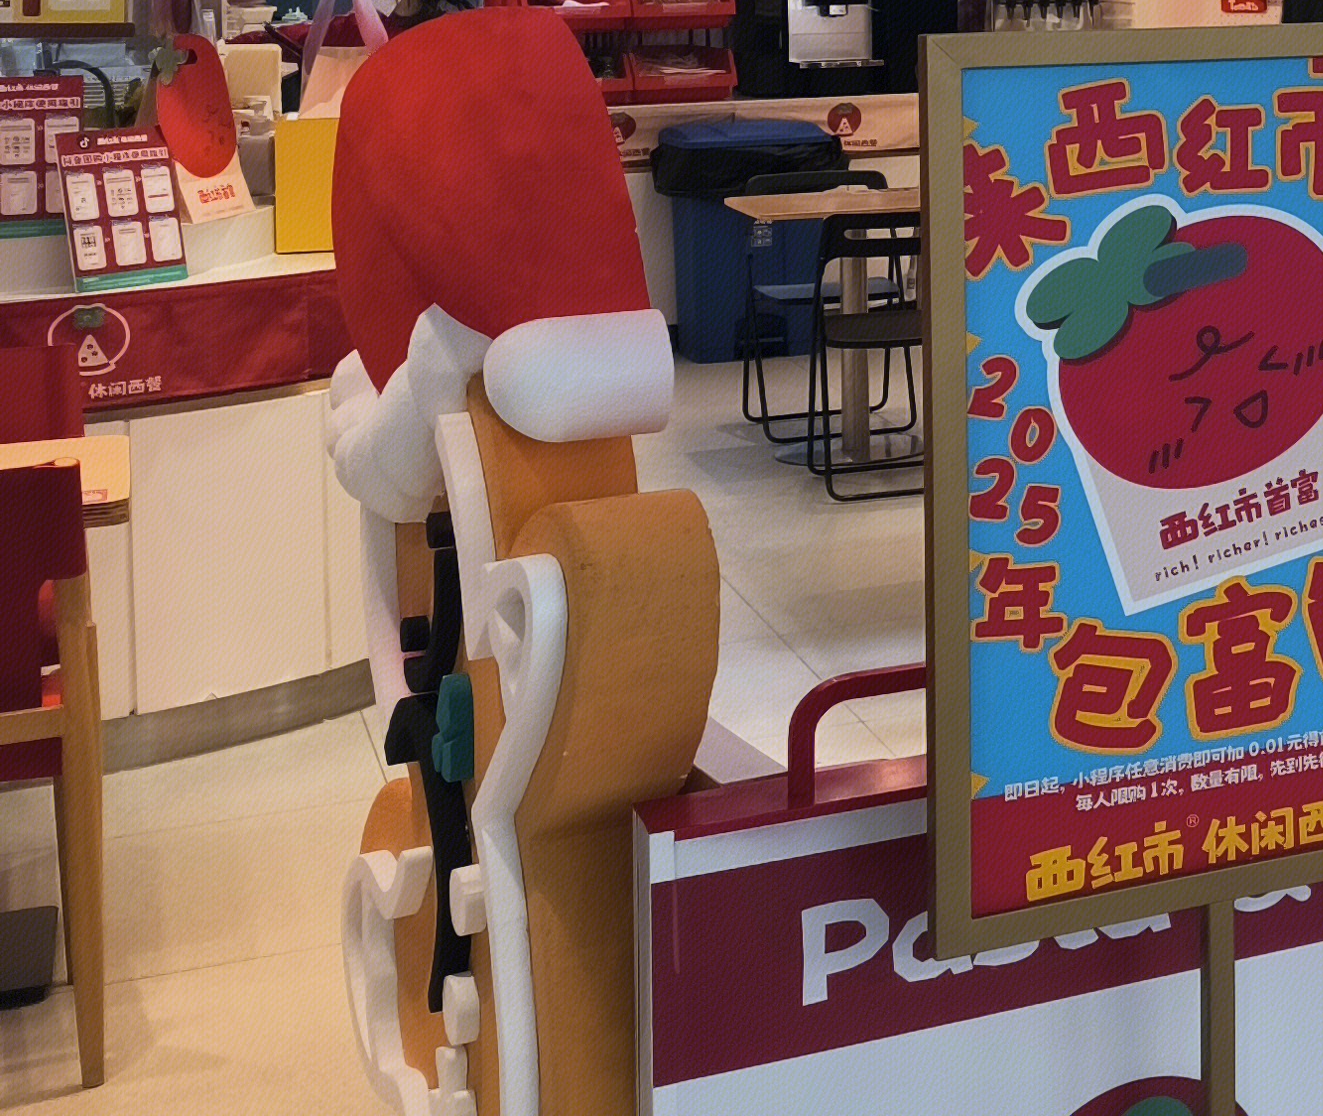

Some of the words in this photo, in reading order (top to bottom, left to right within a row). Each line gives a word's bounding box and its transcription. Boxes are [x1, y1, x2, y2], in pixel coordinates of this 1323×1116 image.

[88, 374, 163, 399] 休闲西餐
[1159, 469, 1320, 550] 西红市首富
[1154, 554, 1200, 582] rich!
[1207, 530, 1270, 564] richer!
[1025, 820, 1186, 902] 西红市
